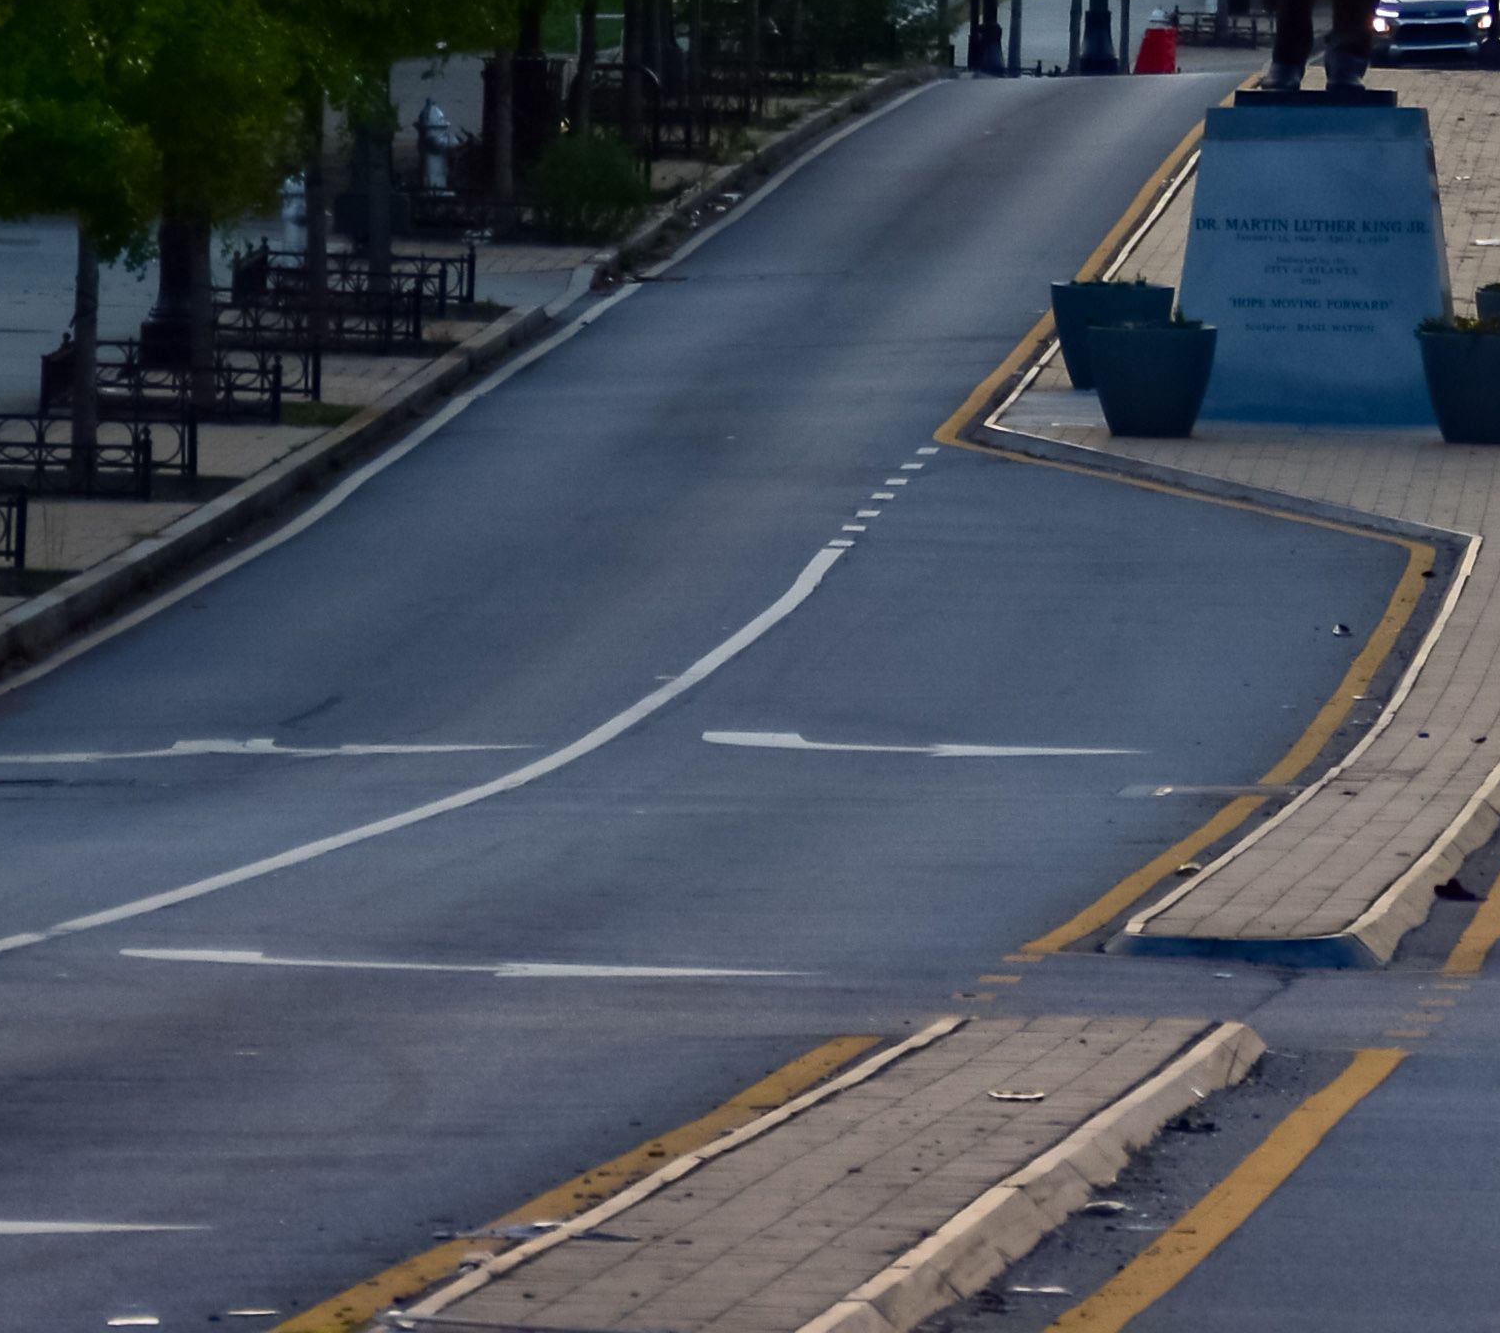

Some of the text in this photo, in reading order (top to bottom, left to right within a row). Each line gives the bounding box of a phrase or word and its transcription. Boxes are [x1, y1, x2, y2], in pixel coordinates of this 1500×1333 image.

[1196, 218, 1430, 234] DR. MARTIN LUTHER KING JR.
[1308, 266, 1358, 275] ATLANTA
[1271, 298, 1321, 309] MOVING
